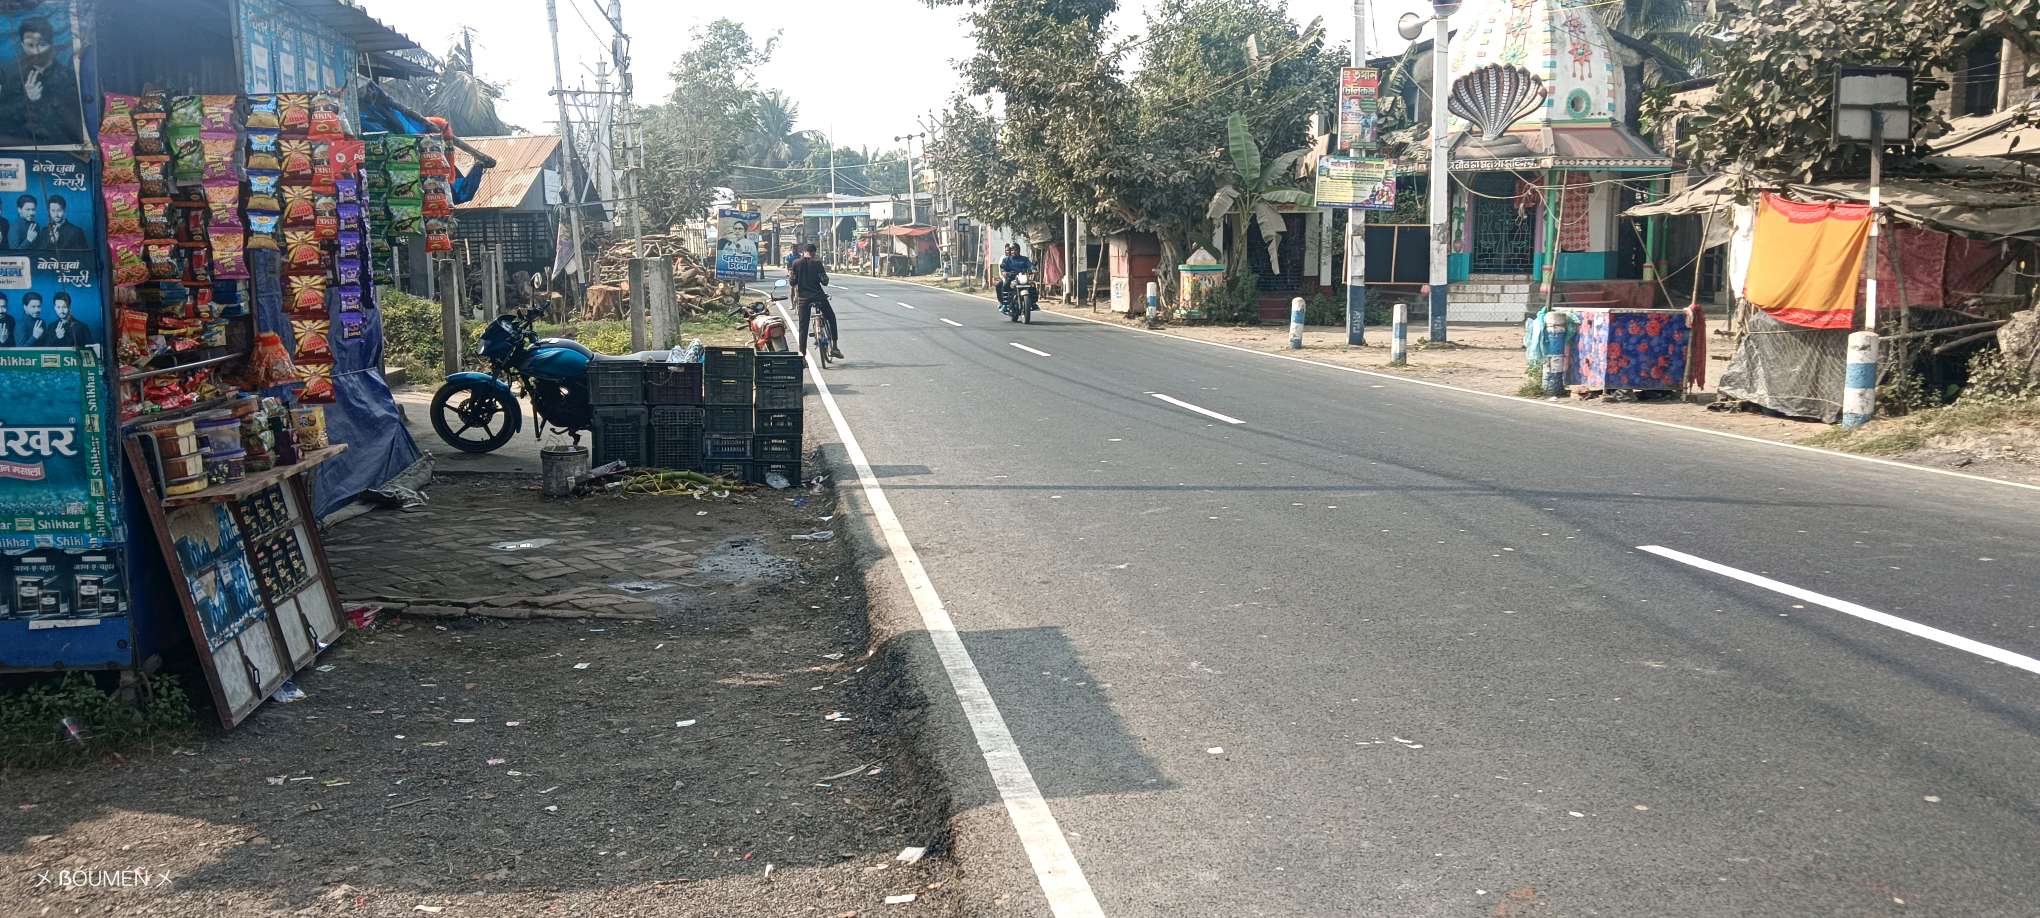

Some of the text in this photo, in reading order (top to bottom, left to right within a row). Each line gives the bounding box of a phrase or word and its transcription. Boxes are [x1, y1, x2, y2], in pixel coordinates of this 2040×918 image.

[85, 370, 97, 412] Shikhar
[90, 436, 102, 476] Shikhar
[38, 519, 80, 530] Shikhar
